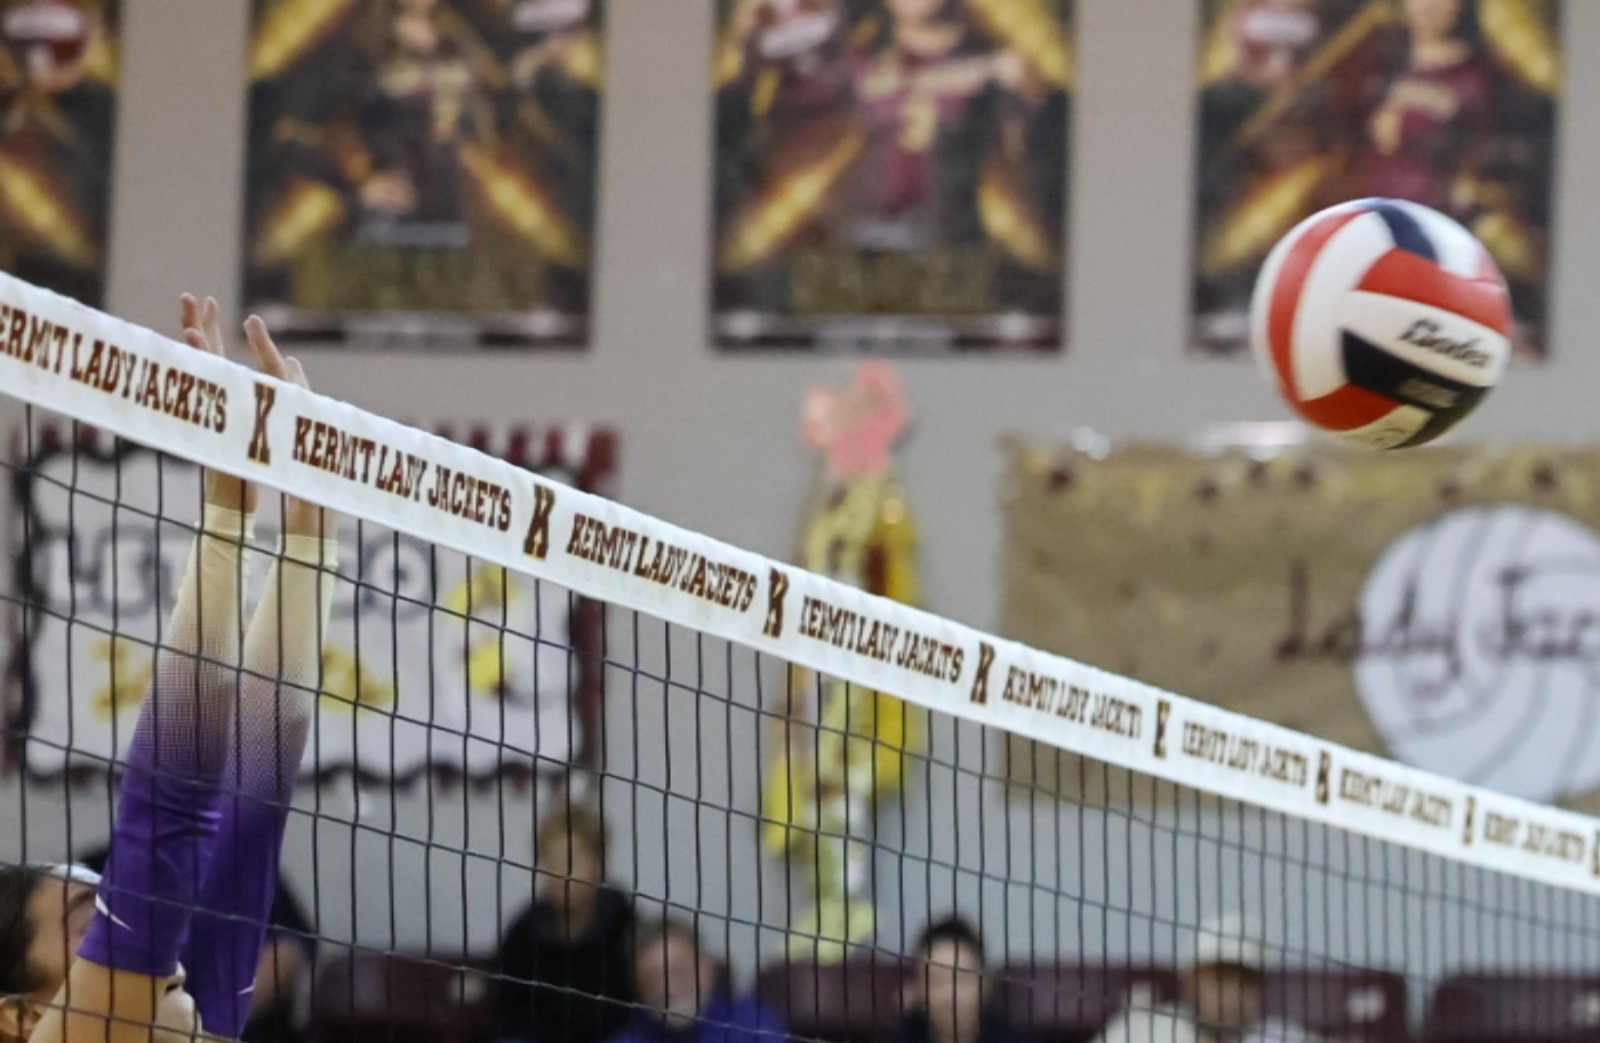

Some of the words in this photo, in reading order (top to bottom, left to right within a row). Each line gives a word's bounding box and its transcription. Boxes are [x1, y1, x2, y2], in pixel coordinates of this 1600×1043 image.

[71, 333, 137, 399] LADY
[135, 358, 228, 434] JACKETS
[248, 381, 276, 465] K
[293, 415, 375, 484] KERMIT
[375, 445, 427, 502] LADY
[428, 464, 512, 532] JACKETS
[524, 482, 555, 561] K
[566, 513, 638, 574] KERMIT
